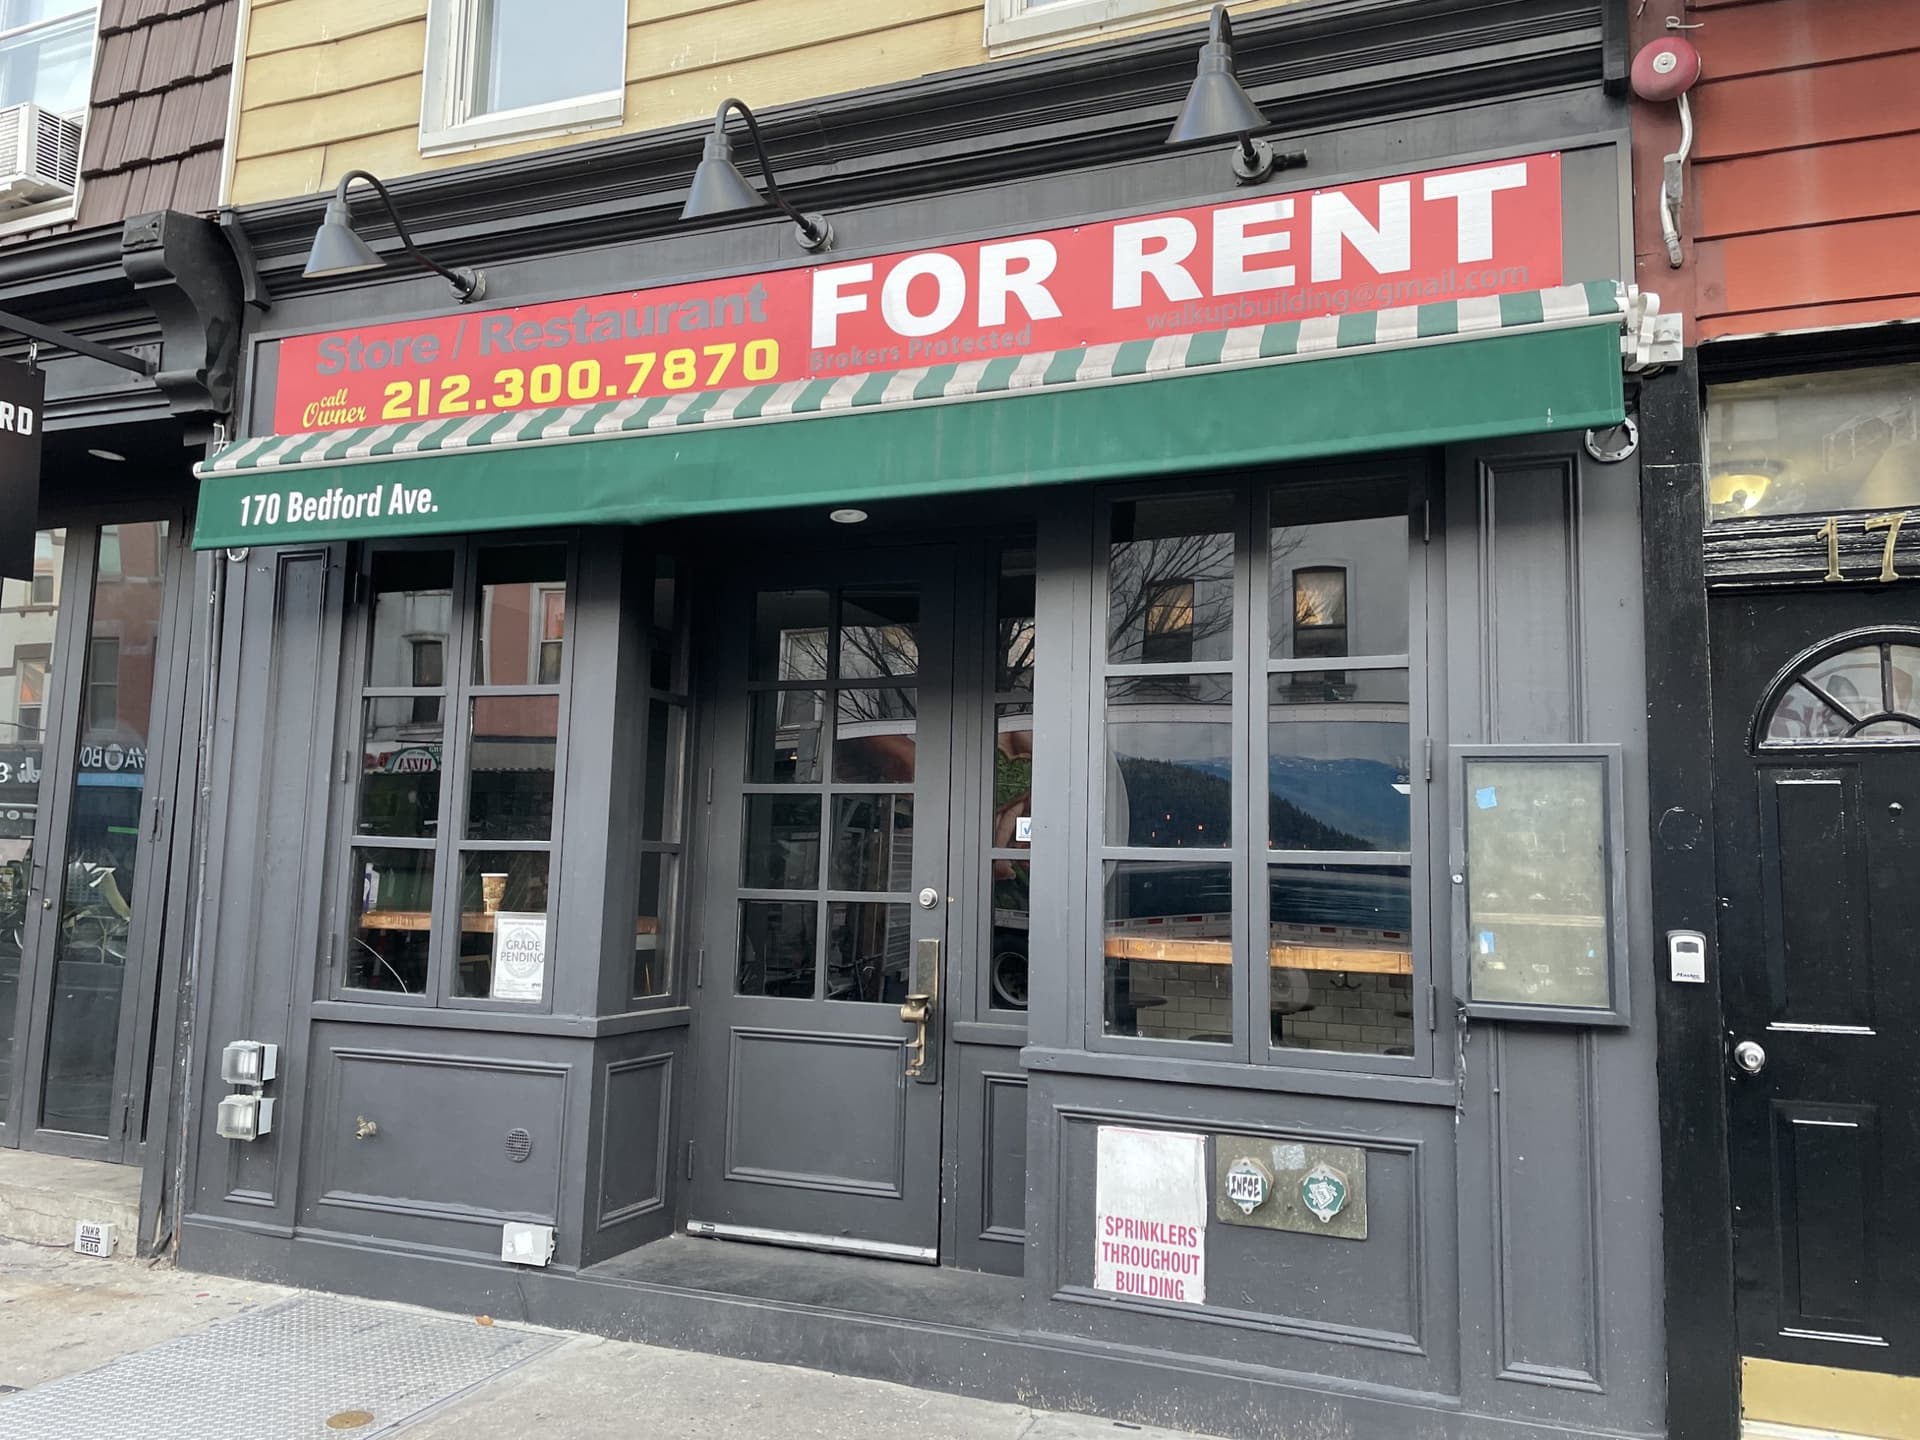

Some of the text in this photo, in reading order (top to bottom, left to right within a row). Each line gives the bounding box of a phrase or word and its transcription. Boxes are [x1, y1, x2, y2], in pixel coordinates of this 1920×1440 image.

[811, 162, 1528, 349] FOR RENT
[1146, 265, 1529, 332] walkupbuilding@gmail.com
[316, 280, 768, 376] Store / Restaurant
[810, 323, 1033, 372] Brokers Protected
[381, 338, 780, 420] 212.300.7870
[320, 388, 348, 406] call
[302, 400, 367, 428] Owner
[240, 483, 439, 527] 170 Bedford Ave.
[500, 952, 544, 963] PENDING
[506, 940, 540, 951] GRADE
[81, 1225, 100, 1236] SNKR
[1105, 1215, 1198, 1248] SPRINKLERS
[81, 1242, 98, 1253] HEAD
[1102, 1242, 1201, 1276] THROUGHOUT
[1115, 1270, 1185, 1301] BUILDING
